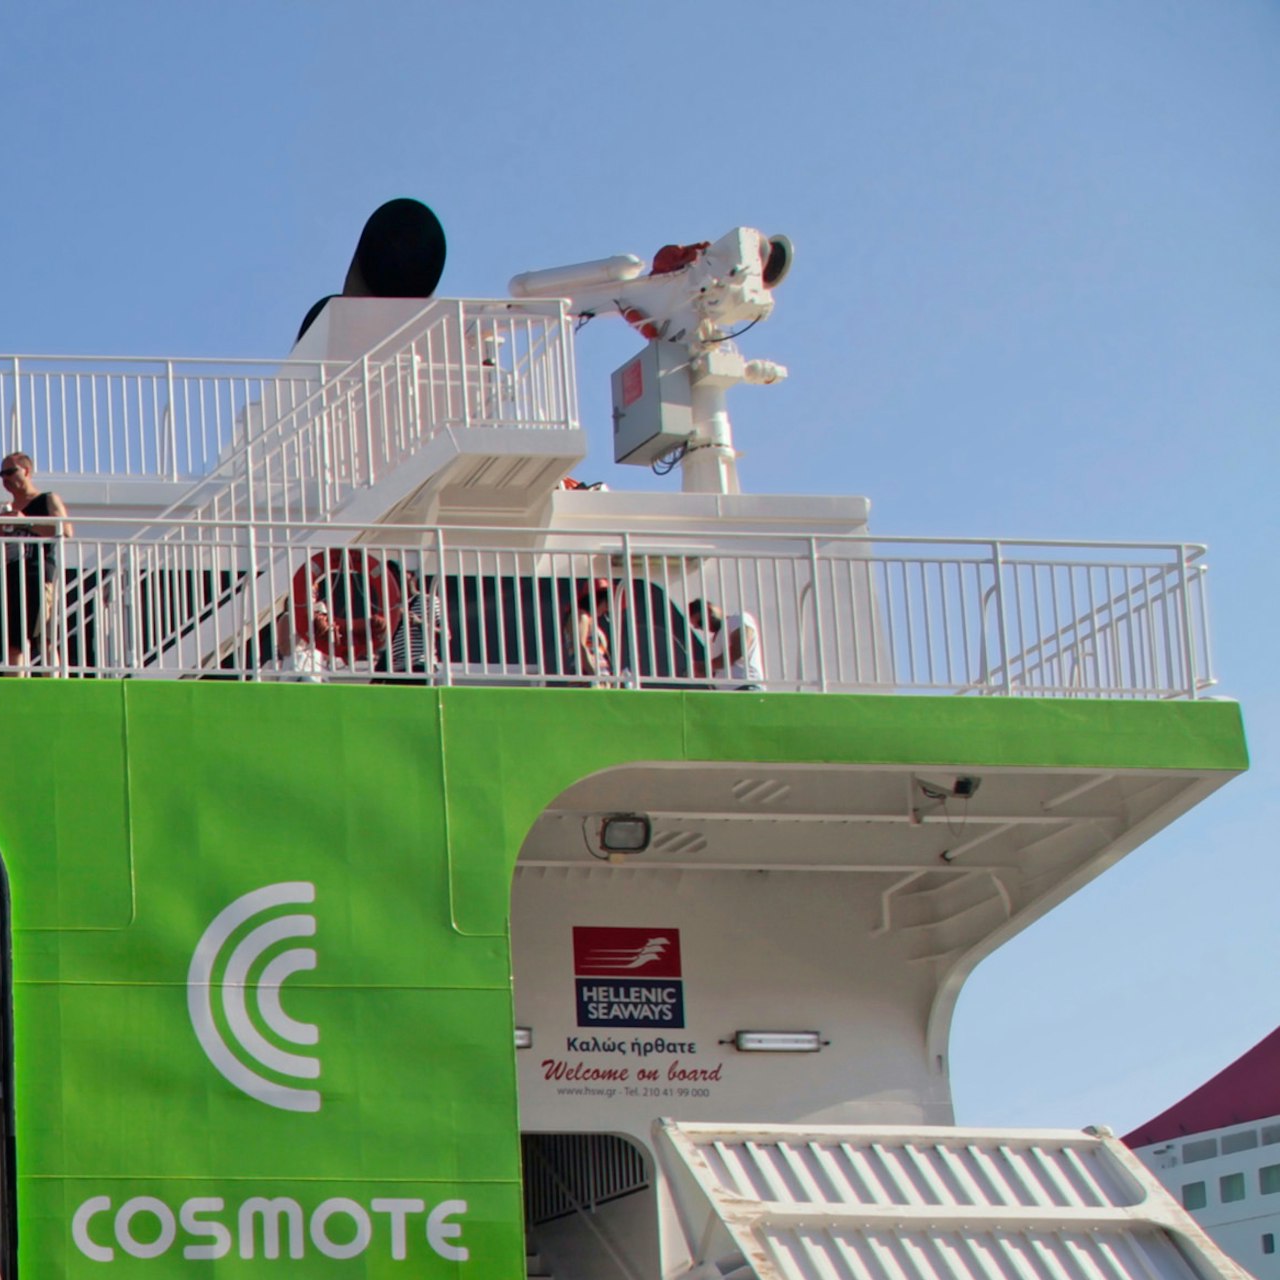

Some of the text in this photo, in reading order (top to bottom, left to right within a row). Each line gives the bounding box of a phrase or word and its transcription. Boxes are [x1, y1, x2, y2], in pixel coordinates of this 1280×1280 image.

[582, 986, 677, 1004] HELLENIC
[587, 1003, 673, 1020] SEAWAYS
[566, 1036, 696, 1056] Καλώς ήρθατε
[540, 1059, 723, 1082] Welcome on board
[556, 1086, 616, 1098] www.hsw.gr
[642, 1087, 660, 1097] 210
[662, 1088, 673, 1097] 41
[677, 1088, 689, 1097] 99
[691, 1088, 710, 1098] 000
[71, 1195, 470, 1263] COSMOTE
